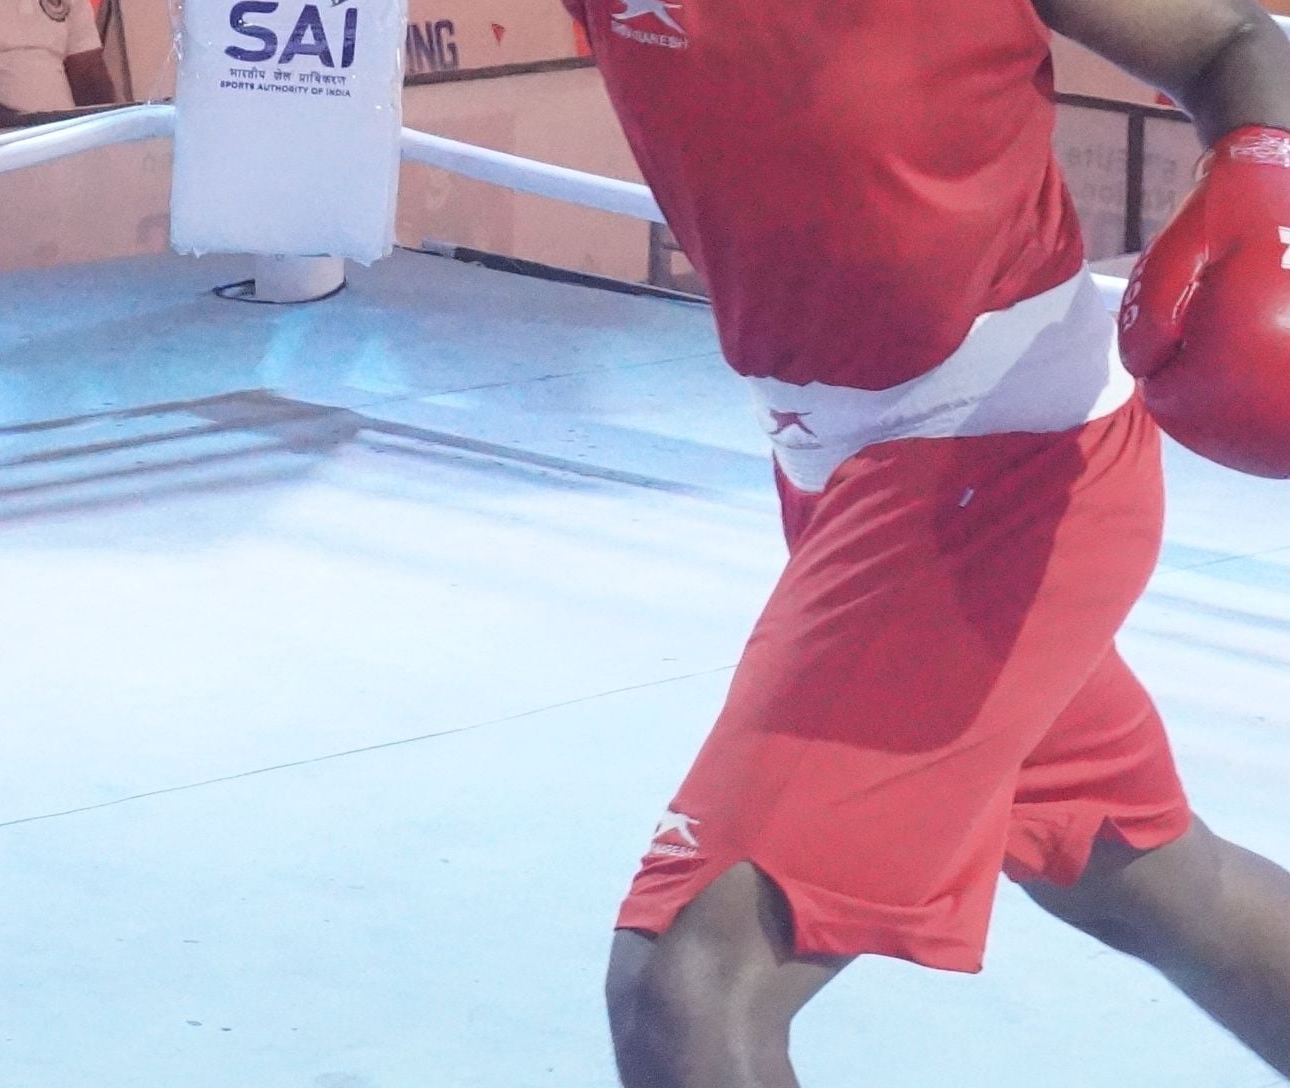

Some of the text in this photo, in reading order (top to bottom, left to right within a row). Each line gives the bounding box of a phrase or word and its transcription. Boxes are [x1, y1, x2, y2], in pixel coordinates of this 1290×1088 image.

[224, 0, 358, 68] SAI
[220, 80, 351, 97] SPORTS AUTHORITY OF INDIA
